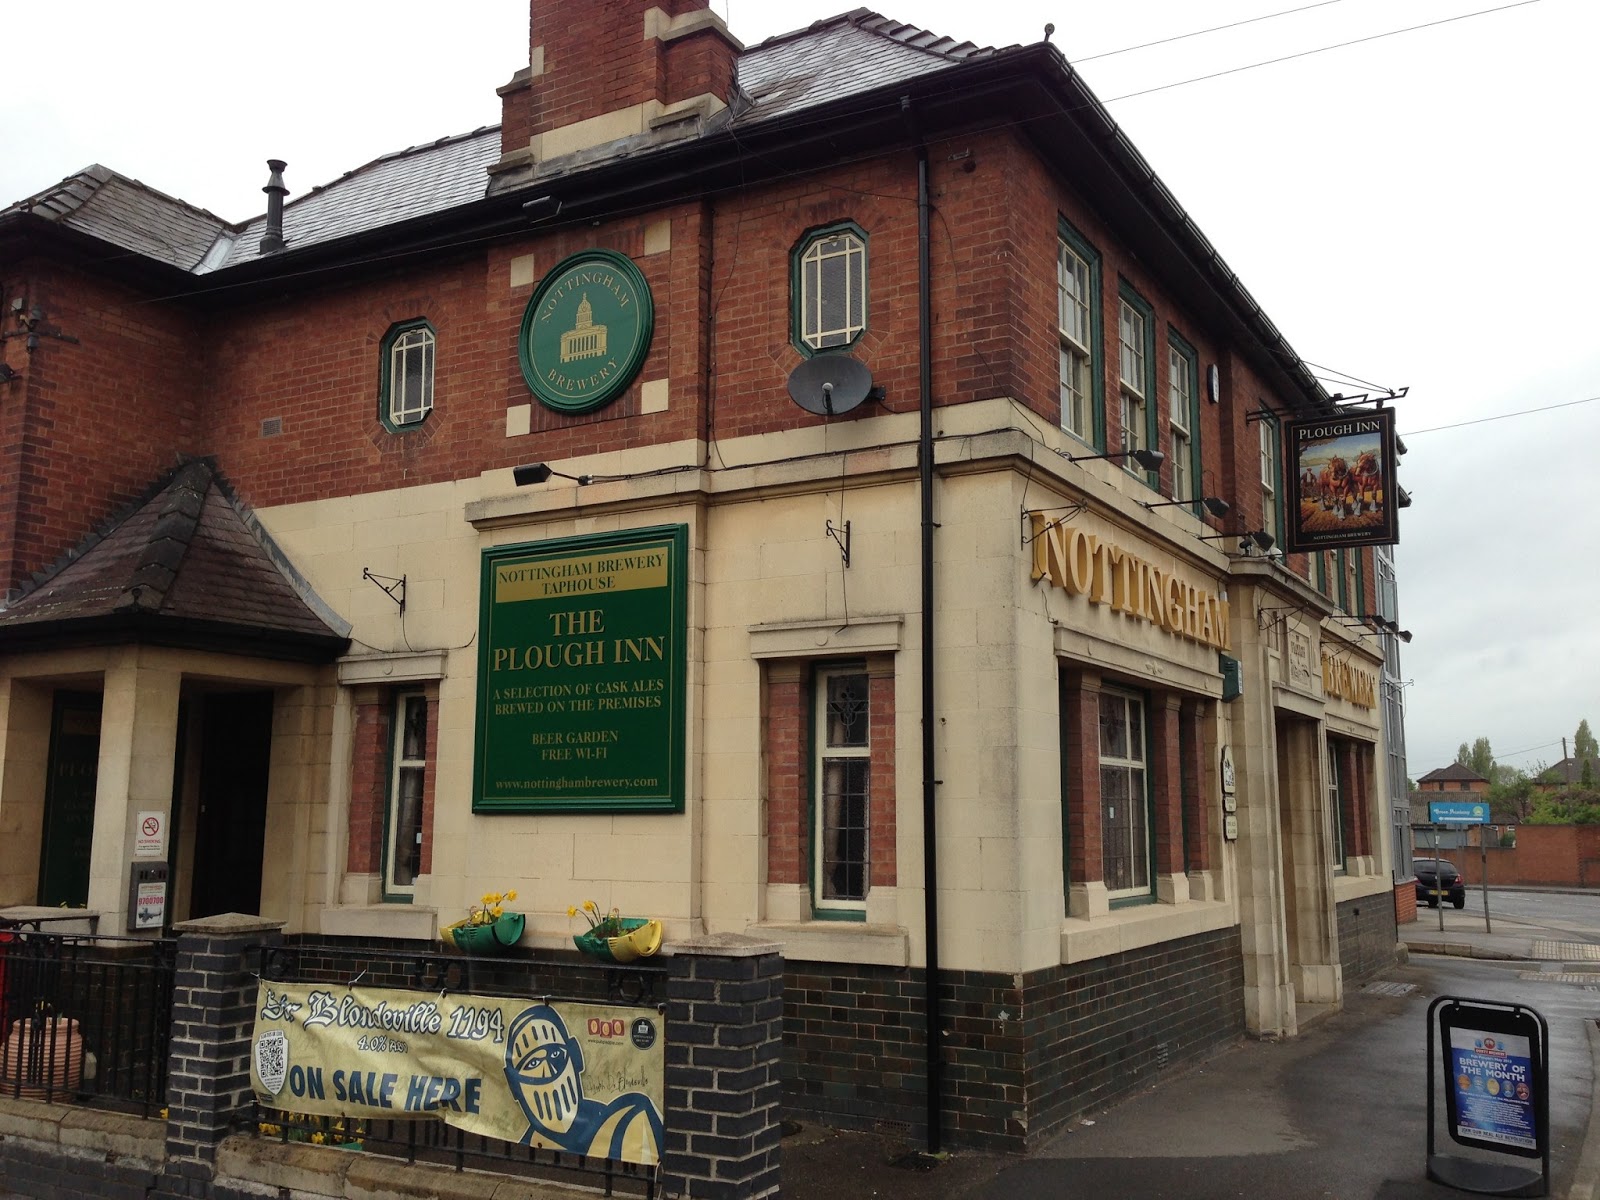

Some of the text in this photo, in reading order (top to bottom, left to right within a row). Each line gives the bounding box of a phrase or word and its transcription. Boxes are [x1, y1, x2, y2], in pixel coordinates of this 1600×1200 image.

[541, 271, 630, 323] NOTTINGHAM
[547, 357, 618, 391] BREWERY
[1299, 420, 1381, 440] PLOUGH INN
[499, 553, 665, 584] NOTTINGHAM BREWERY
[541, 575, 616, 596] TAPHOUSE
[1031, 510, 1232, 652] NOTTINGHAM
[549, 609, 606, 637] THE
[492, 636, 666, 673] PLOUGH INN
[493, 678, 665, 700] A SELECTION OF CASK ALES
[494, 694, 662, 716] BREWED ON THE PREMISES
[531, 729, 620, 746] BEER GARDEN
[541, 748, 608, 762] FREE WI-FI
[495, 774, 659, 791] www.nottinghambrewery.com
[261, 988, 505, 1044] Sir Blondeville 1194
[356, 1034, 387, 1053] 4.0%
[1459, 1057, 1526, 1073] BREWERY OF
[1461, 1066, 1525, 1082] THE MONTH
[289, 1064, 483, 1115] ON SALE HERE
